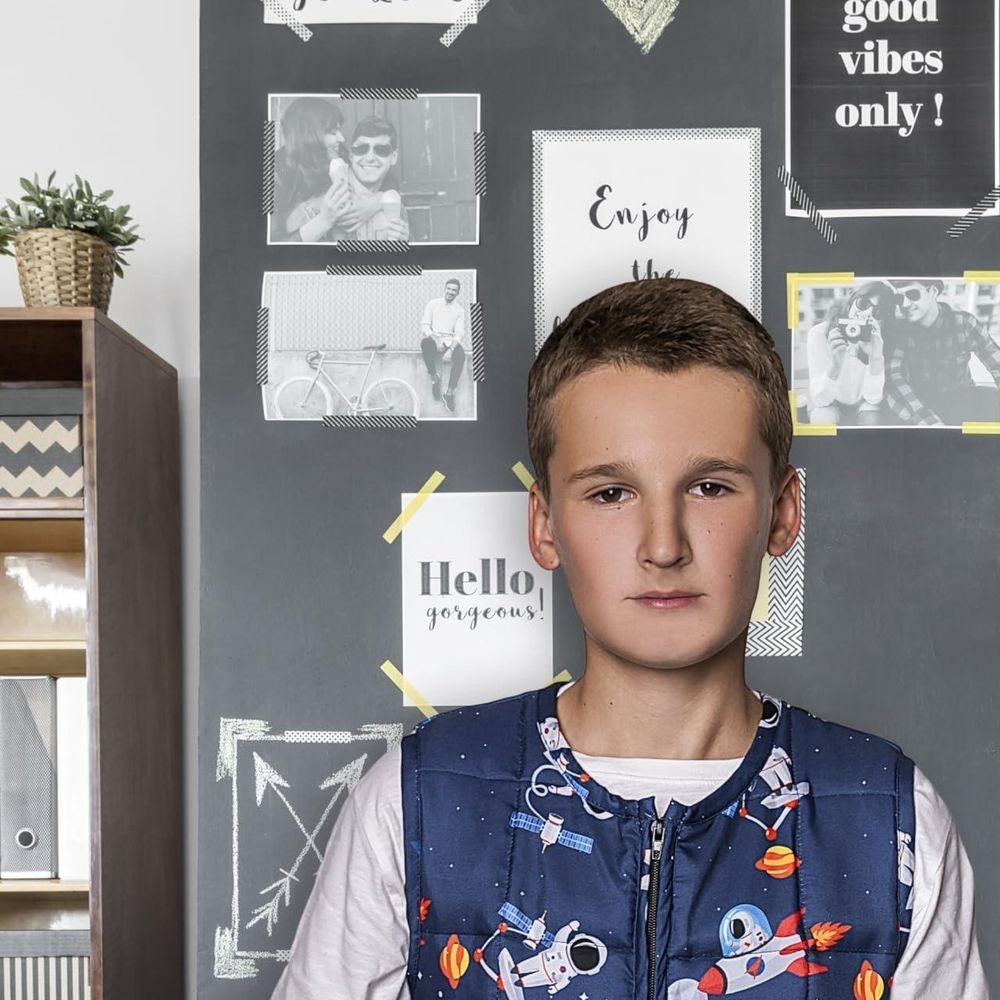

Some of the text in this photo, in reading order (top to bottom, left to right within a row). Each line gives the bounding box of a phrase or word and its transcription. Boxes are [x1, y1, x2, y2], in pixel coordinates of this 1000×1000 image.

[842, 0, 939, 33] good
[838, 39, 944, 75] vibes
[835, 91, 924, 137] only
[588, 184, 693, 242] Enjoy
[418, 558, 535, 596] Hello
[426, 587, 545, 631] gorgeous!
